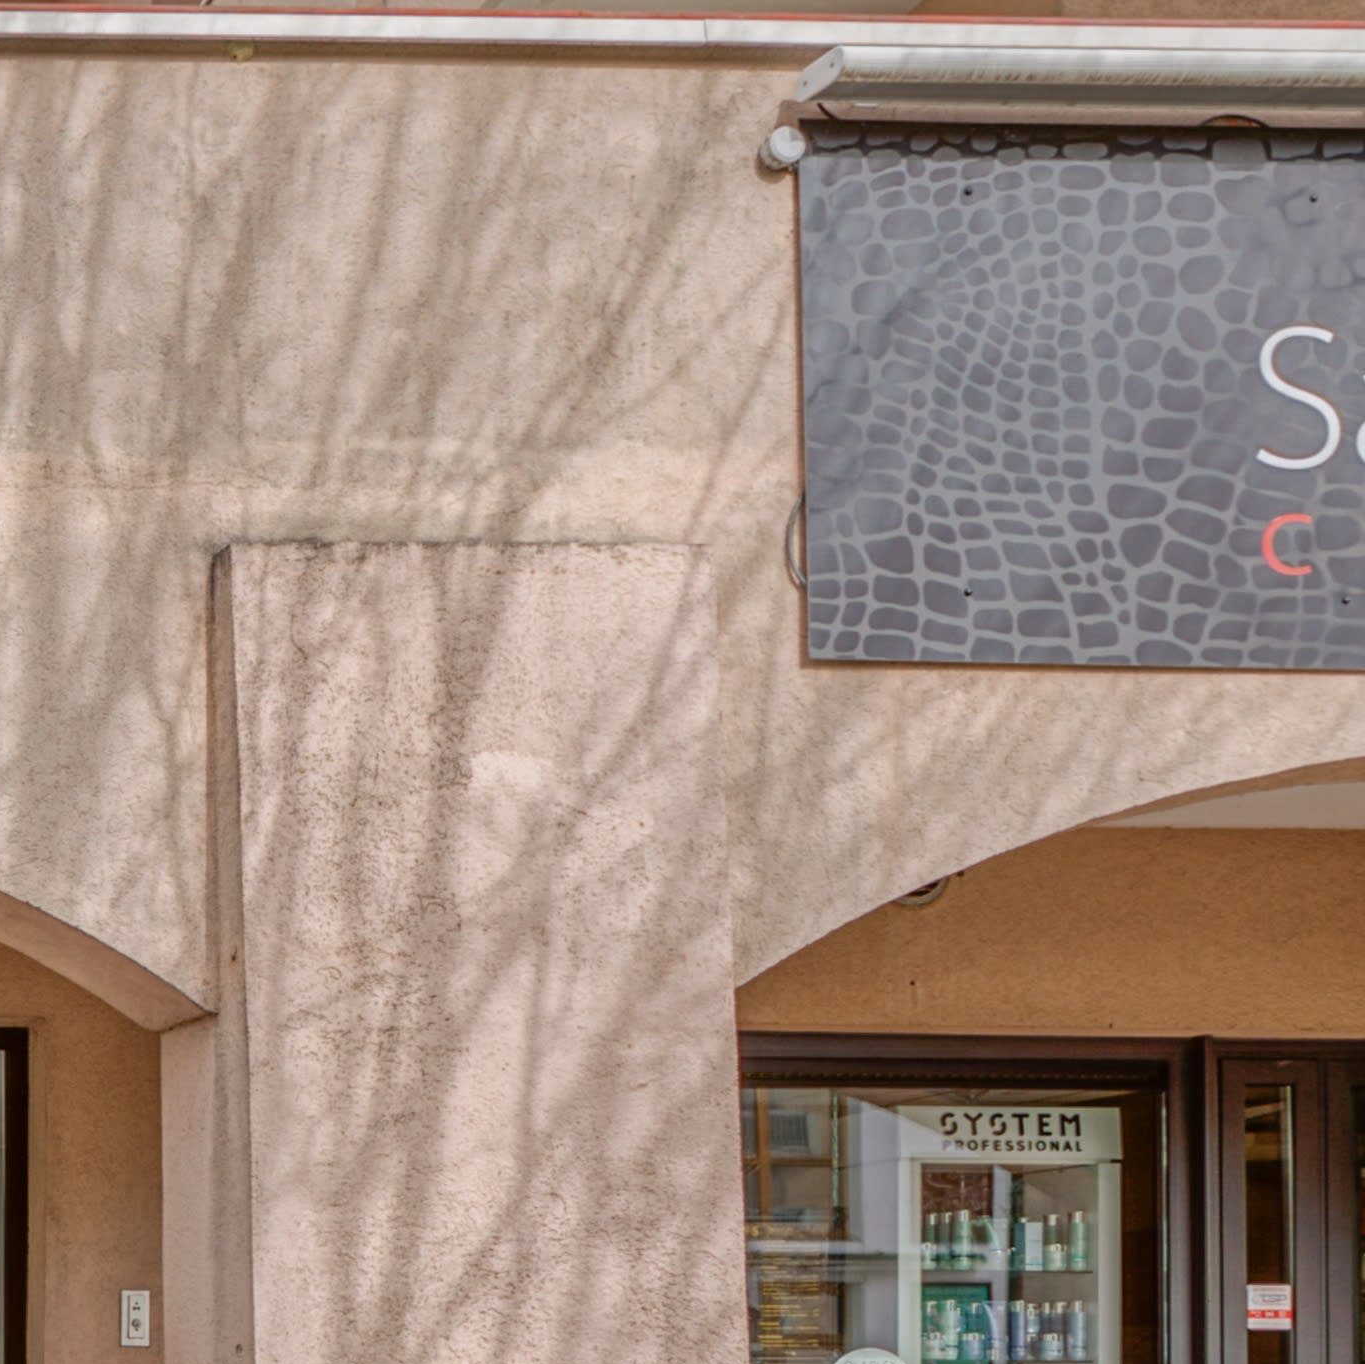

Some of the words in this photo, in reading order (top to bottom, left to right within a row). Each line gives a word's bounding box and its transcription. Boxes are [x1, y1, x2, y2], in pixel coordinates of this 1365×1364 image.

[1255, 325, 1365, 470] S
[940, 1112, 1082, 1137] SYSTEM
[942, 1139, 1083, 1153] PROFESSIONAL
